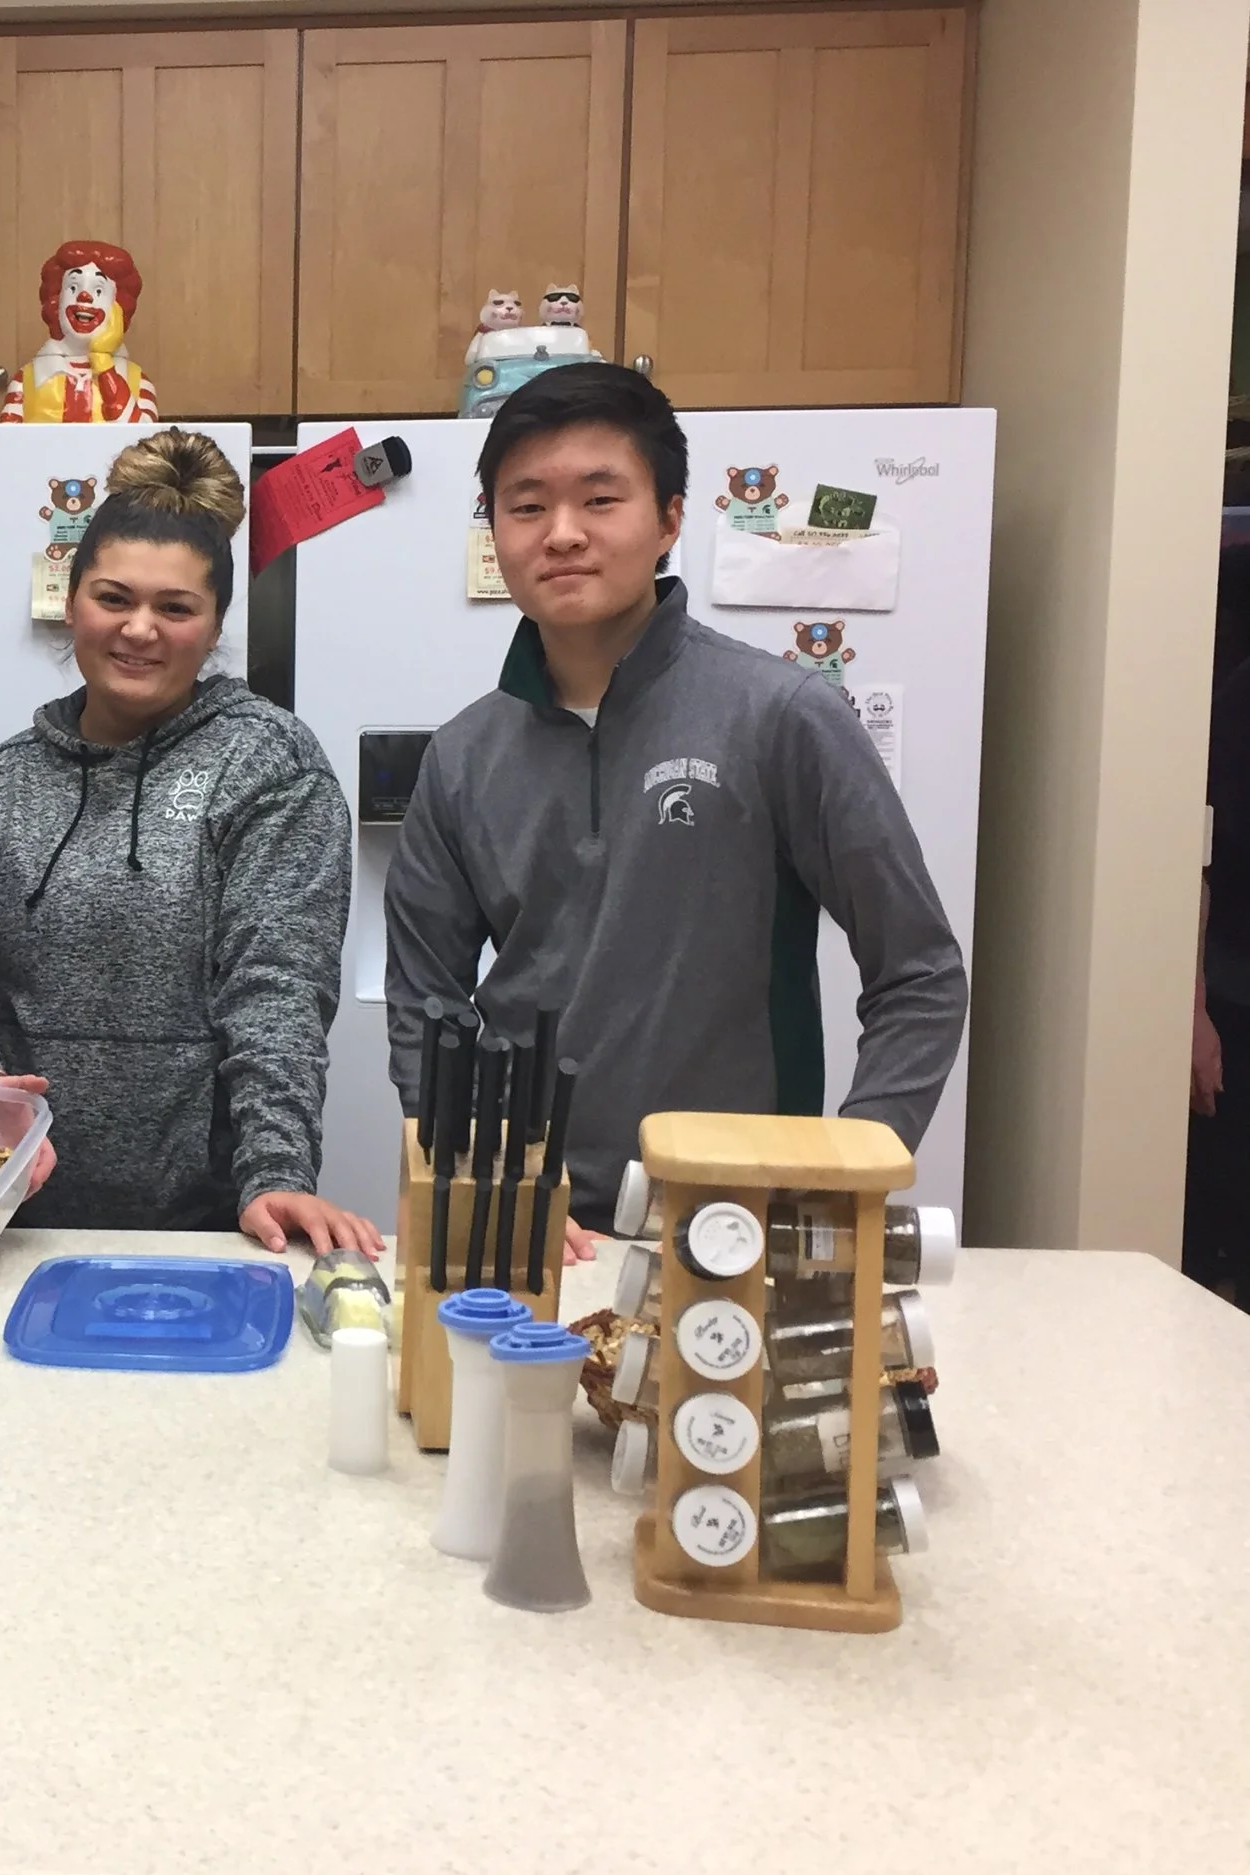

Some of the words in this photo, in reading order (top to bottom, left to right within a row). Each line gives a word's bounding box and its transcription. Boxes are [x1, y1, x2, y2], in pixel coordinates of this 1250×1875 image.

[875, 462, 940, 478] Whirlpool
[688, 757, 721, 788] STATE
[165, 808, 198, 821] PAW
